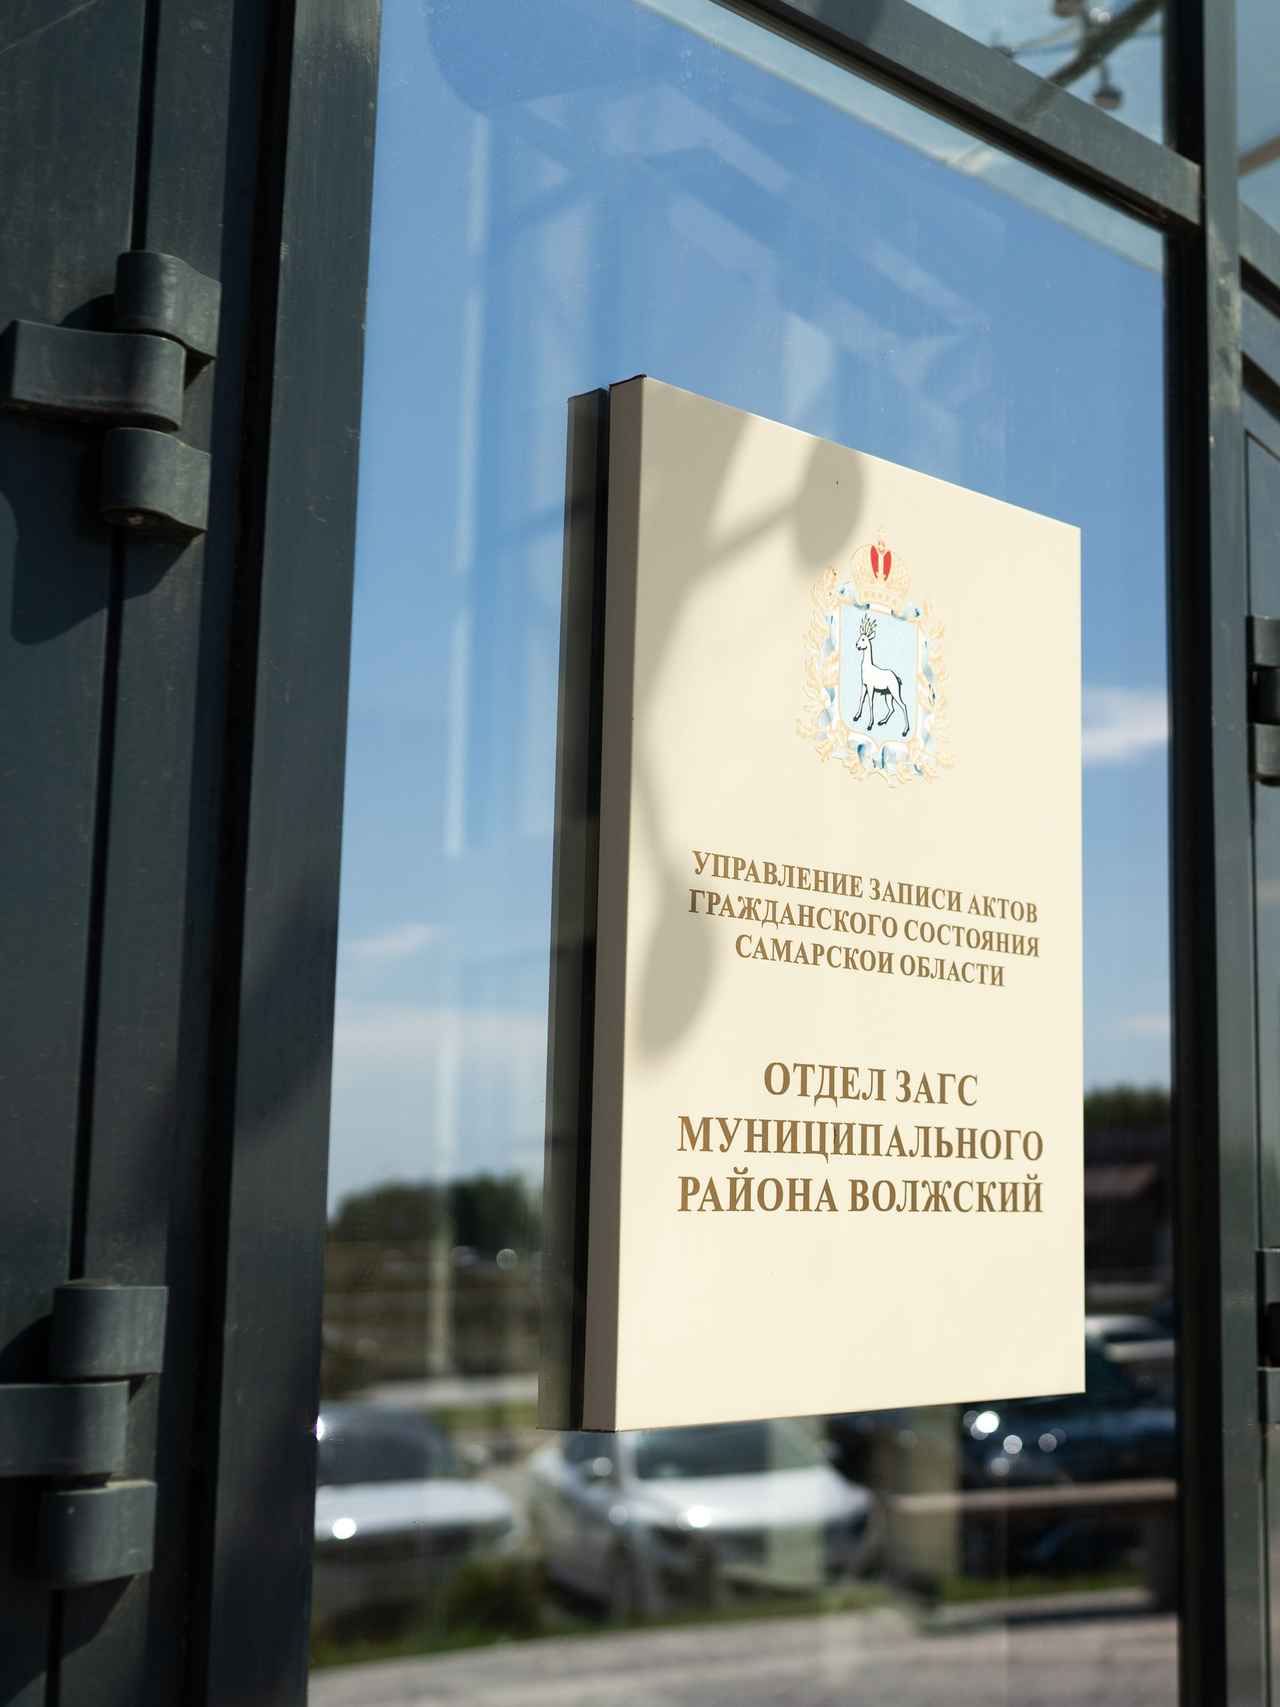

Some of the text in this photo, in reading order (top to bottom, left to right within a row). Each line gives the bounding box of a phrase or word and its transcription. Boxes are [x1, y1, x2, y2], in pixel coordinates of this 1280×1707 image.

[691, 850, 1038, 924] УПРАВЛЕНИЕ ЗАПИСИ АКТОВ
[688, 888, 1041, 958] ГРАЖДАНСКОГО СОСТОЯНИЯ
[899, 954, 1006, 987] ОБЛАСТИ
[763, 1062, 979, 1108] ОТДЕЛ ЗАГС
[677, 1115, 1045, 1164] МУНИЦИПАЛЬНОГО
[677, 1166, 1045, 1214] РАЙОНА ВОЛЖСКИЙ
